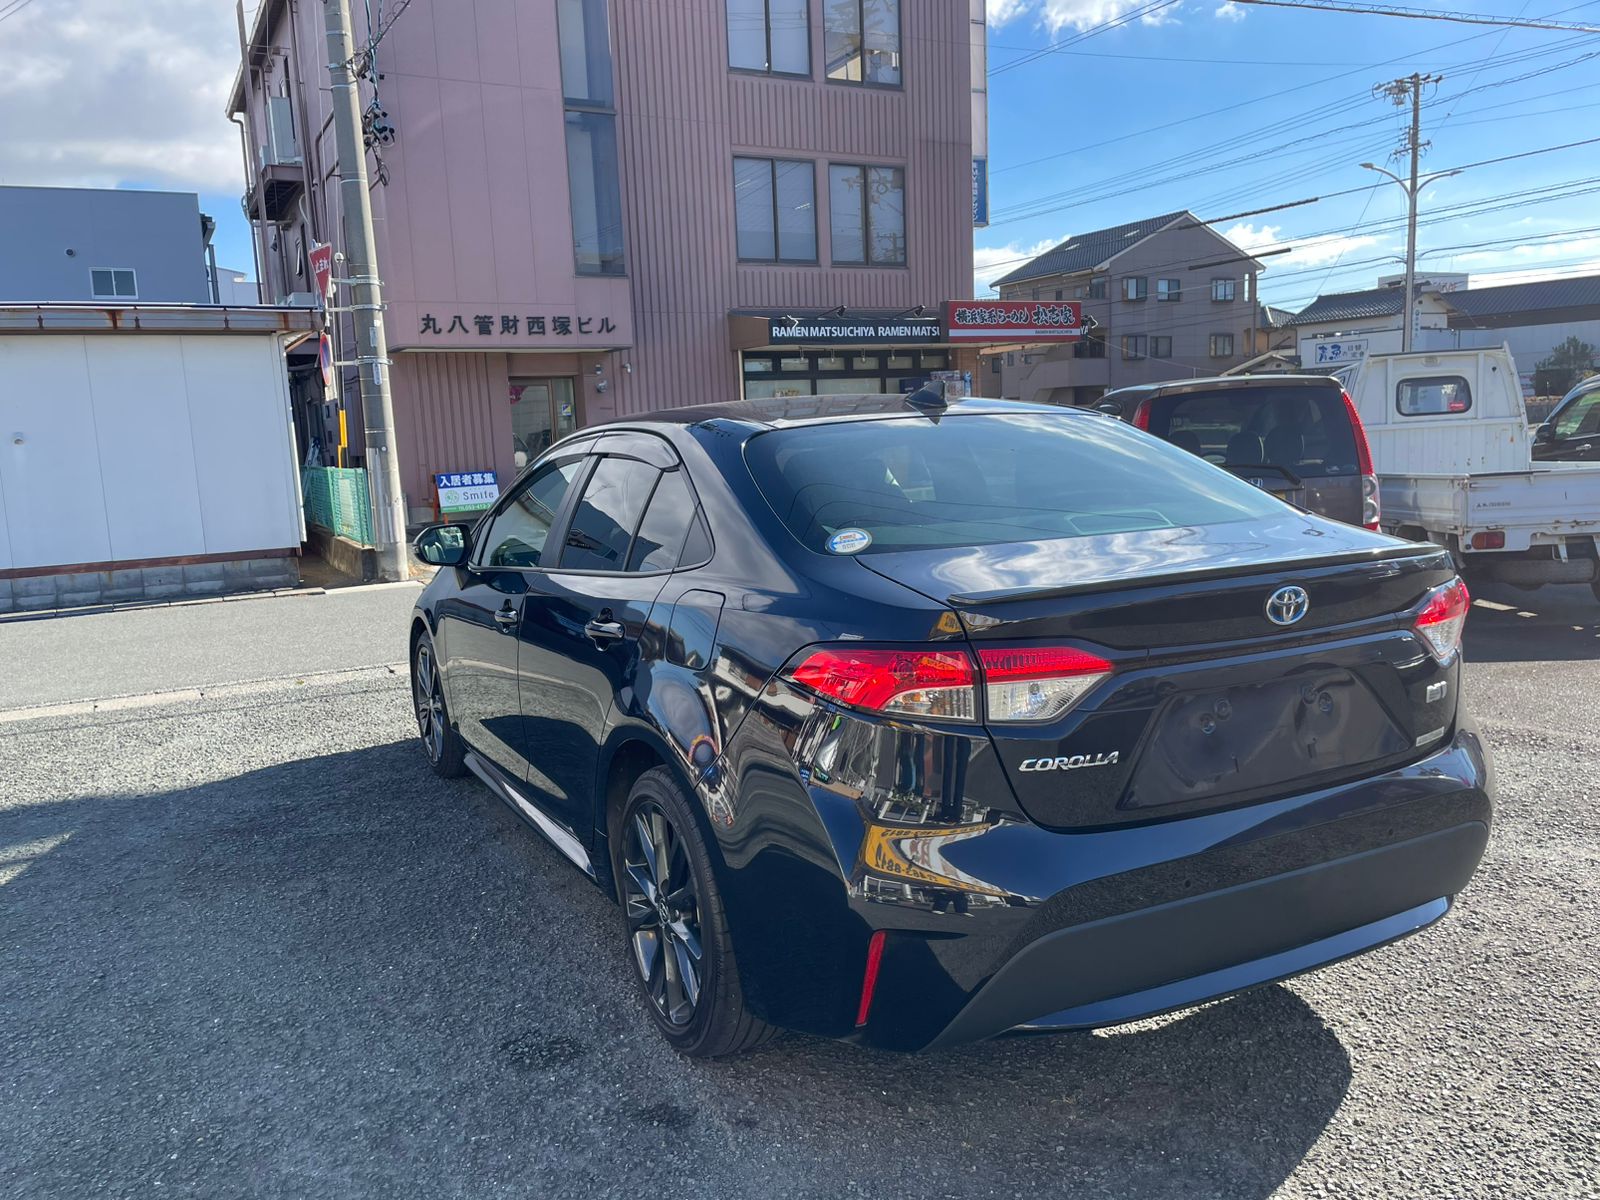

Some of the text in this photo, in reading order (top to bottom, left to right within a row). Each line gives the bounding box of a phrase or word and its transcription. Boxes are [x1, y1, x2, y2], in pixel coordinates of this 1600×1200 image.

[420, 313, 616, 336] 丸八管財西塚ビル
[955, 307, 1029, 325] 横浜家系らーめん
[772, 326, 808, 337] RAMEN
[810, 326, 876, 337] MATSUICHIYA
[878, 326, 912, 336] RAMEN
[440, 472, 495, 487] 入居者募集
[1018, 751, 1120, 772] COROLLA
